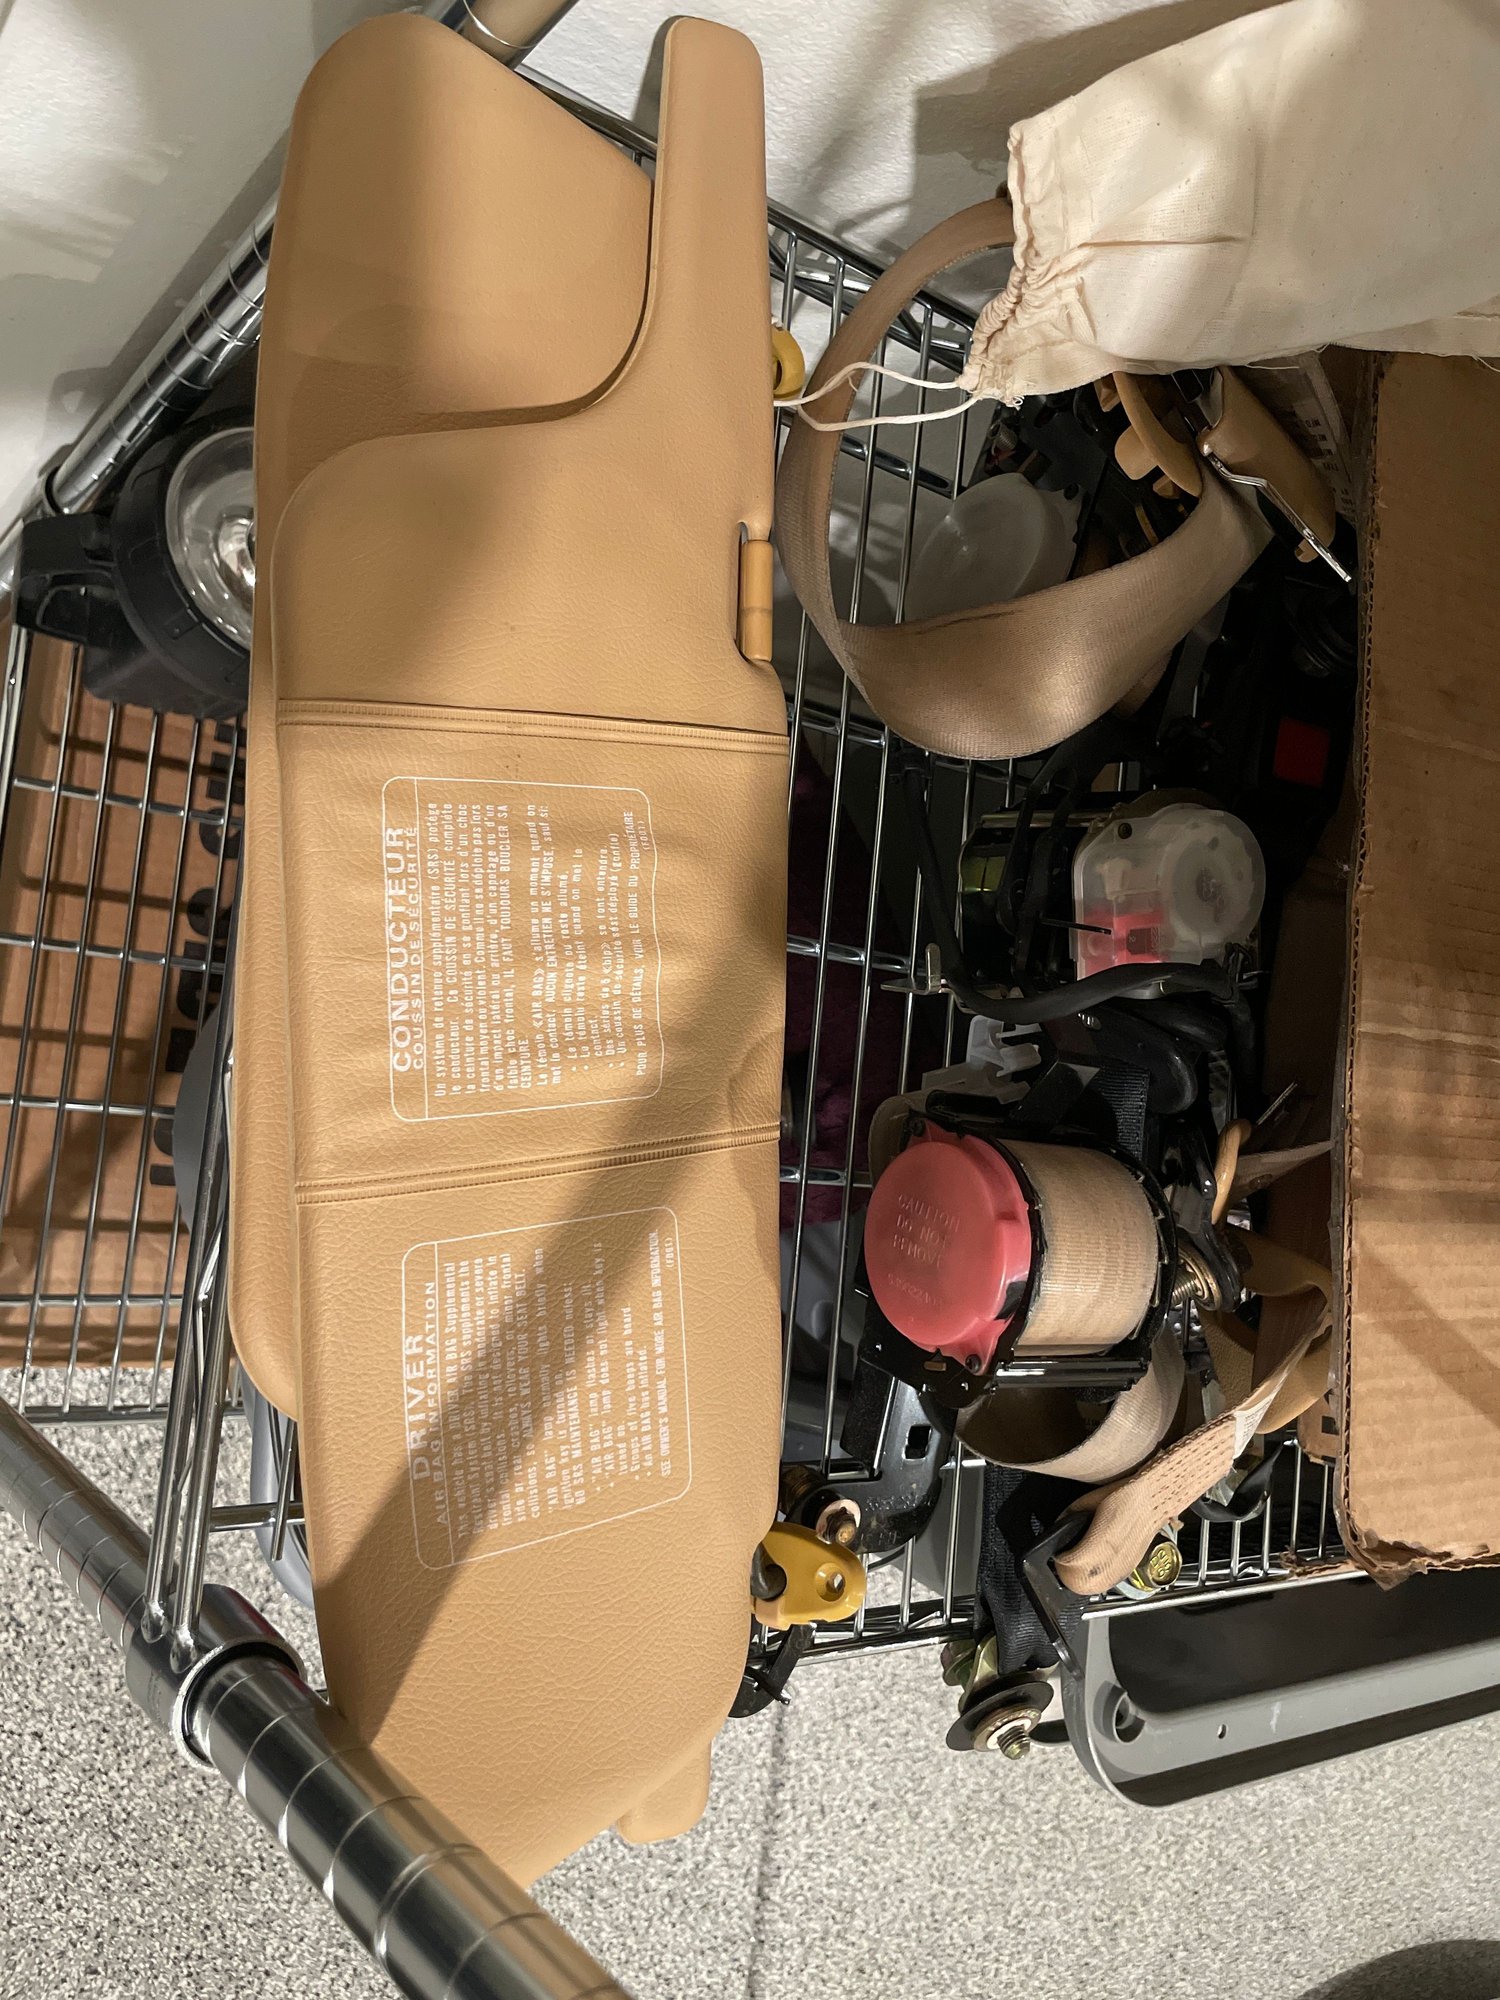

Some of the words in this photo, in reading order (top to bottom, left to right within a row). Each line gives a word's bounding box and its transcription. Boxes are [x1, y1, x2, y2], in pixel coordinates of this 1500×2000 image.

[457, 804, 468, 828] choc
[471, 804, 481, 824] lors
[484, 805, 495, 827] d'un
[457, 834, 468, 857] d'un
[472, 827, 483, 845] pas
[498, 825, 511, 872] BOUCLER
[623, 811, 640, 869] PROPRIÉTAIRE
[404, 827, 420, 931] SÉCURITÉ
[427, 848, 439, 879] (SRS)
[458, 863, 468, 882] lors
[472, 848, 484, 885] déploie
[486, 851, 499, 897] capotage
[529, 857, 540, 895] moment
[571, 864, 582, 882] met
[440, 860, 456, 910] SÉCURITÉ
[429, 885, 444, 966] supplémentaire
[458, 888, 472, 930] gonflant
[487, 903, 498, 925] d'un
[386, 827, 411, 1072] CONDUCTEUR
[444, 936, 457, 983] COUSSIN
[501, 938, 513, 961] FAUT
[541, 918, 558, 967] ENTRETIEN
[632, 939, 643, 959] VOIR
[476, 965, 487, 1005] violent.
[545, 972, 557, 1002] AUCUN
[503, 985, 516, 1023] frontal,
[411, 974, 424, 1069] COUSSIN
[479, 1023, 489, 1054] moyen
[633, 1024, 646, 1046] PLUS
[463, 1037, 475, 1078] ceinture
[493, 1029, 503, 1063] impact
[504, 1029, 516, 1053] choc
[478, 1058, 490, 1092] frontal
[636, 1052, 647, 1075] POUR
[458, 1260, 470, 1277] the
[473, 1258, 484, 1292] severe
[443, 1262, 458, 1333] Supplemental
[487, 1270, 499, 1304] inflate
[459, 1280, 473, 1346] supplements
[425, 1282, 439, 1432] INFORMATION
[445, 1338, 457, 1360] BAG
[460, 1351, 473, 1371] SRS
[516, 1333, 529, 1362] YOUR
[445, 1365, 458, 1383] AIR
[655, 1358, 666, 1375] FOR
[405, 1335, 431, 1480] DRIVER
[656, 1378, 669, 1414] MANUAL
[567, 1386, 583, 1458] MAINTENANCE
[430, 1440, 443, 1482] BAG
[573, 1463, 584, 1484] SRS
[435, 1489, 448, 1524] AIR
